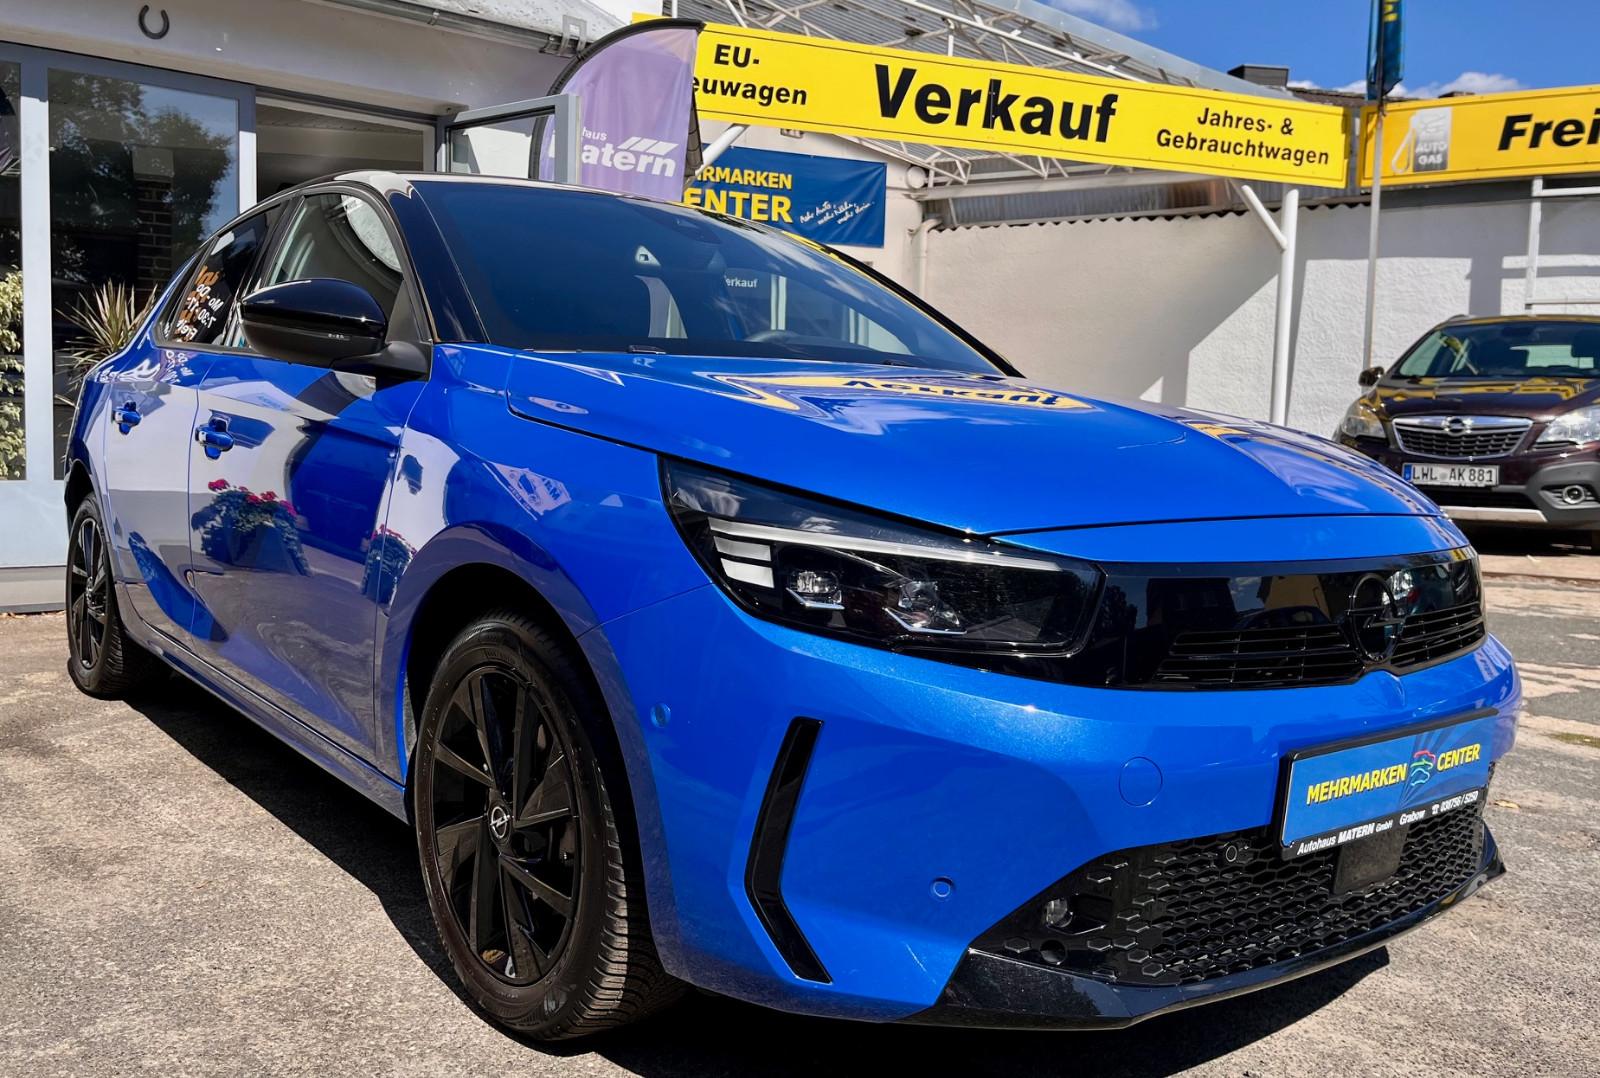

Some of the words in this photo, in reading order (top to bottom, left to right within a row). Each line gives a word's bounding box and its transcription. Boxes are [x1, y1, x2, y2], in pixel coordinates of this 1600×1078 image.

[714, 44, 760, 68] EU-
[874, 63, 1118, 143] Verkauf
[1196, 107, 1273, 134] Jahres-
[1280, 117, 1295, 136] &
[581, 142, 677, 177] atern
[1156, 128, 1329, 168] Gebrauchtwagen
[1415, 141, 1448, 153] AUTO
[1418, 153, 1443, 165] GAS
[723, 273, 758, 288] erkauf
[1412, 466, 1438, 480] LWL
[1449, 468, 1466, 481] AK
[1468, 468, 1493, 482] 881
[1306, 763, 1407, 805] MEHRMARKEN
[1436, 743, 1481, 771] CENTER
[1296, 836, 1337, 855] Autohaus
[1337, 822, 1375, 844] MATERN
[1376, 820, 1394, 832] GmbH
